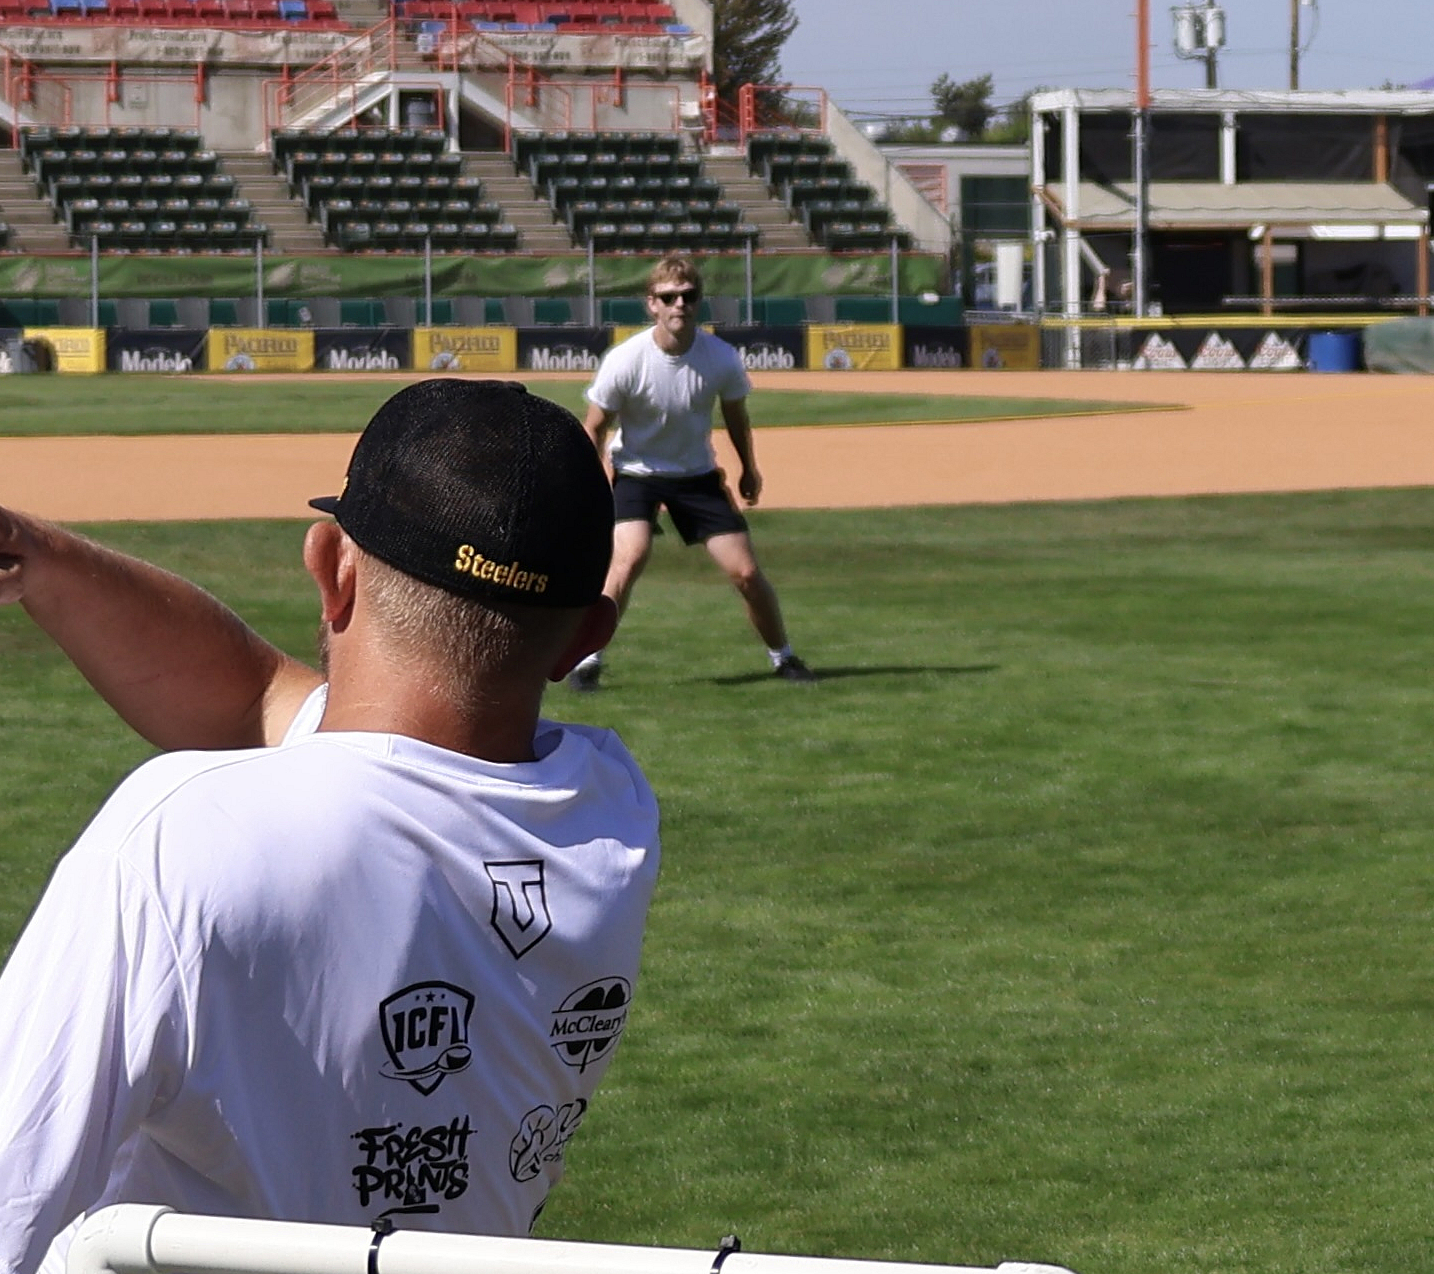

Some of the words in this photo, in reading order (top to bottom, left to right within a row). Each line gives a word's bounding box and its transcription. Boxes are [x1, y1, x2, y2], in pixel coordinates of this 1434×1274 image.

[122, 350, 192, 373] Modelo
[330, 350, 399, 370] Modelo
[531, 347, 599, 370] Modelo
[914, 345, 962, 366] Modelo
[454, 544, 549, 593] Steelers
[351, 1115, 477, 1169] FRESH
[352, 1159, 469, 1207] PRINTS
